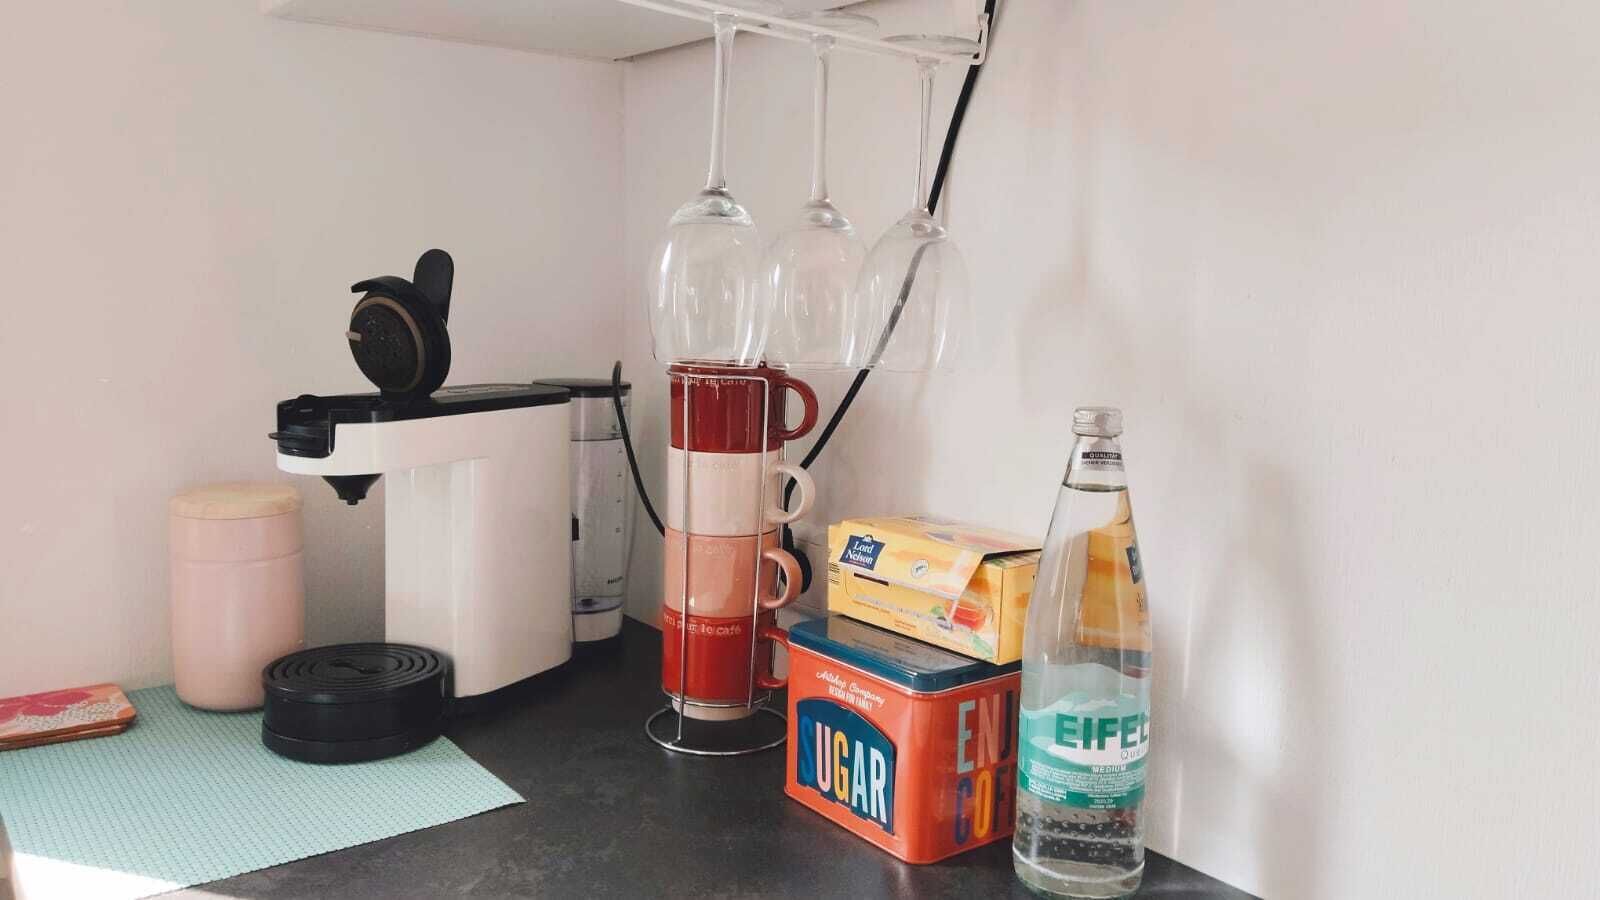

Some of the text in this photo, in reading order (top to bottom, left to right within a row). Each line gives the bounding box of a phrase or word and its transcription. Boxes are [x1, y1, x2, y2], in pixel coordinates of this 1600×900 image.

[846, 549, 874, 565] Nelson
[853, 541, 875, 554] Lord
[849, 682, 885, 708] Company
[957, 689, 1013, 775] ENJ
[801, 714, 887, 824] SUGAR
[1092, 763, 1127, 774] MEDIUM
